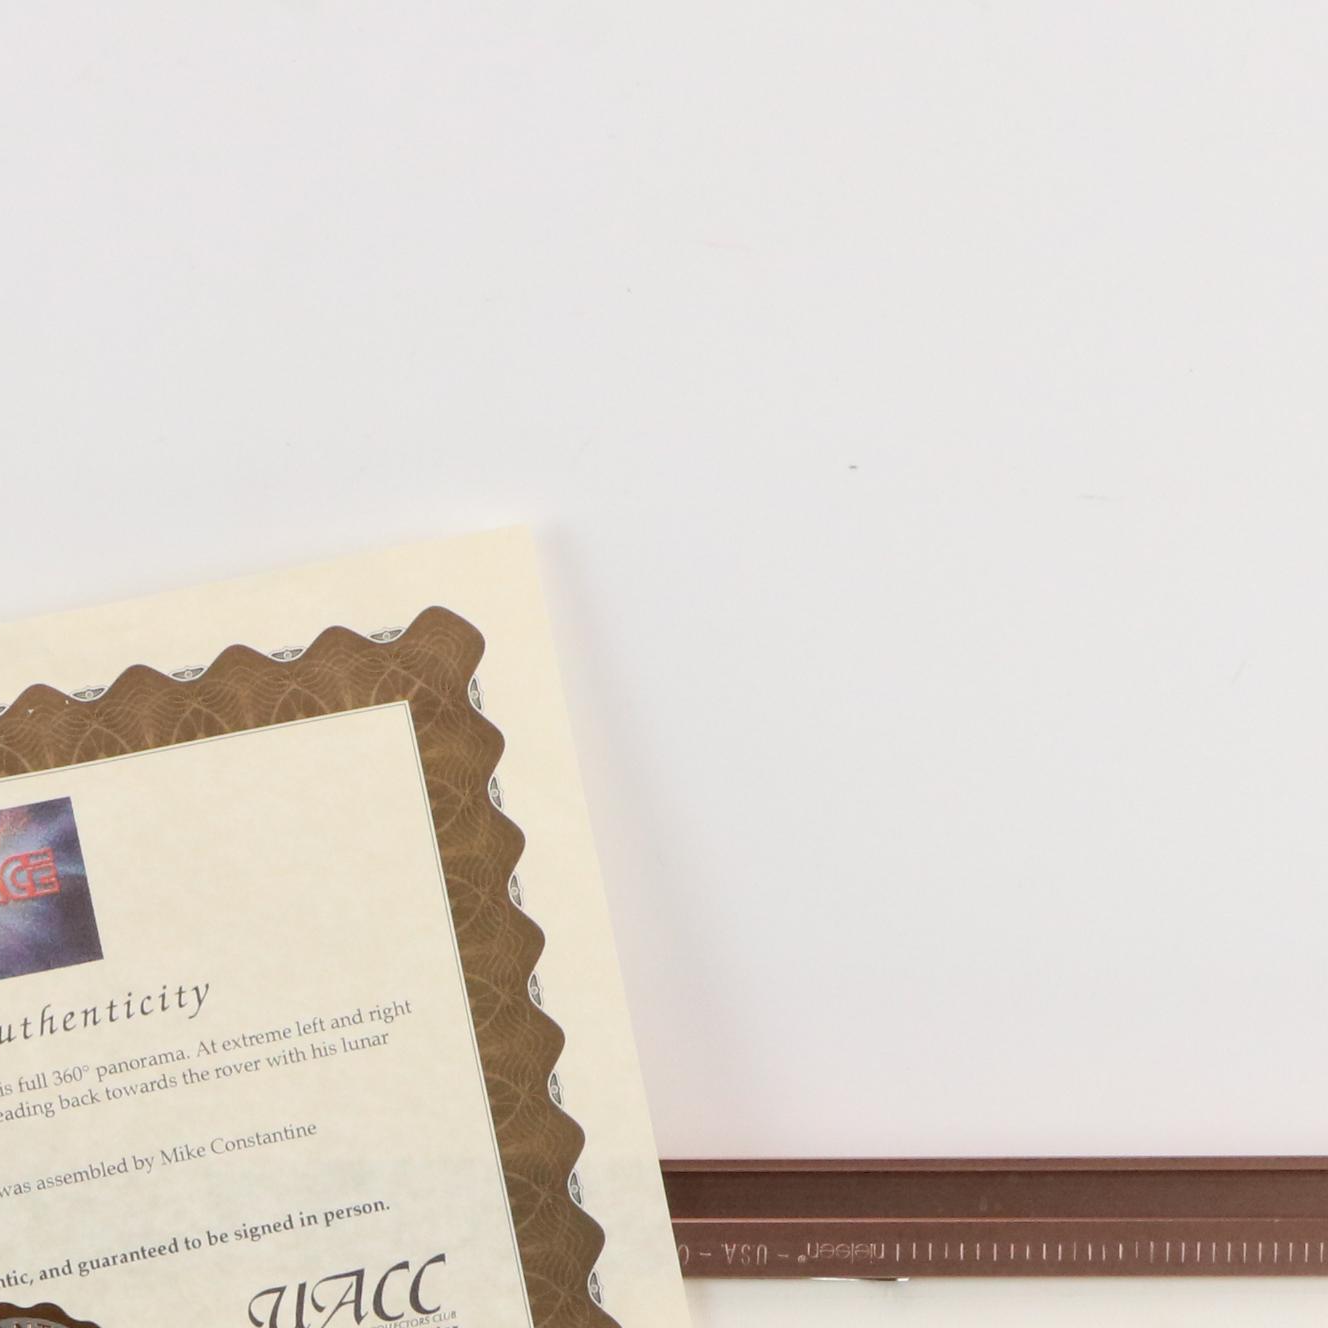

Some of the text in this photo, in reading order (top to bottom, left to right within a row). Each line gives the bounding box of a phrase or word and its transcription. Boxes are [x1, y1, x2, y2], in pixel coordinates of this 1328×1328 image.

[17, 1071, 49, 1093] full
[94, 1048, 190, 1083] panorama.
[196, 1038, 218, 1057] At
[220, 1026, 292, 1052] extreme
[294, 1016, 326, 1037] left
[329, 1007, 364, 1030] and
[367, 999, 412, 1024] right
[57, 1087, 101, 1110] back
[104, 1072, 178, 1101] towards
[180, 1067, 210, 1086] the
[213, 1057, 261, 1079] rover
[264, 1045, 307, 1068] with
[309, 1040, 338, 1059] his
[339, 1031, 389, 1053] lunar
[35, 1156, 129, 1191] assembled
[130, 1154, 154, 1174] by
[159, 1142, 206, 1166] Mike
[209, 1123, 317, 1154] Constantine
[38, 1257, 73, 1281] and
[76, 1236, 180, 1278] guaranteed
[182, 1235, 202, 1251] to
[204, 1228, 229, 1247] be
[232, 1212, 295, 1242] signed
[298, 1210, 319, 1228] in
[322, 1199, 390, 1228] person.
[432, 1310, 457, 1323] CLUB
